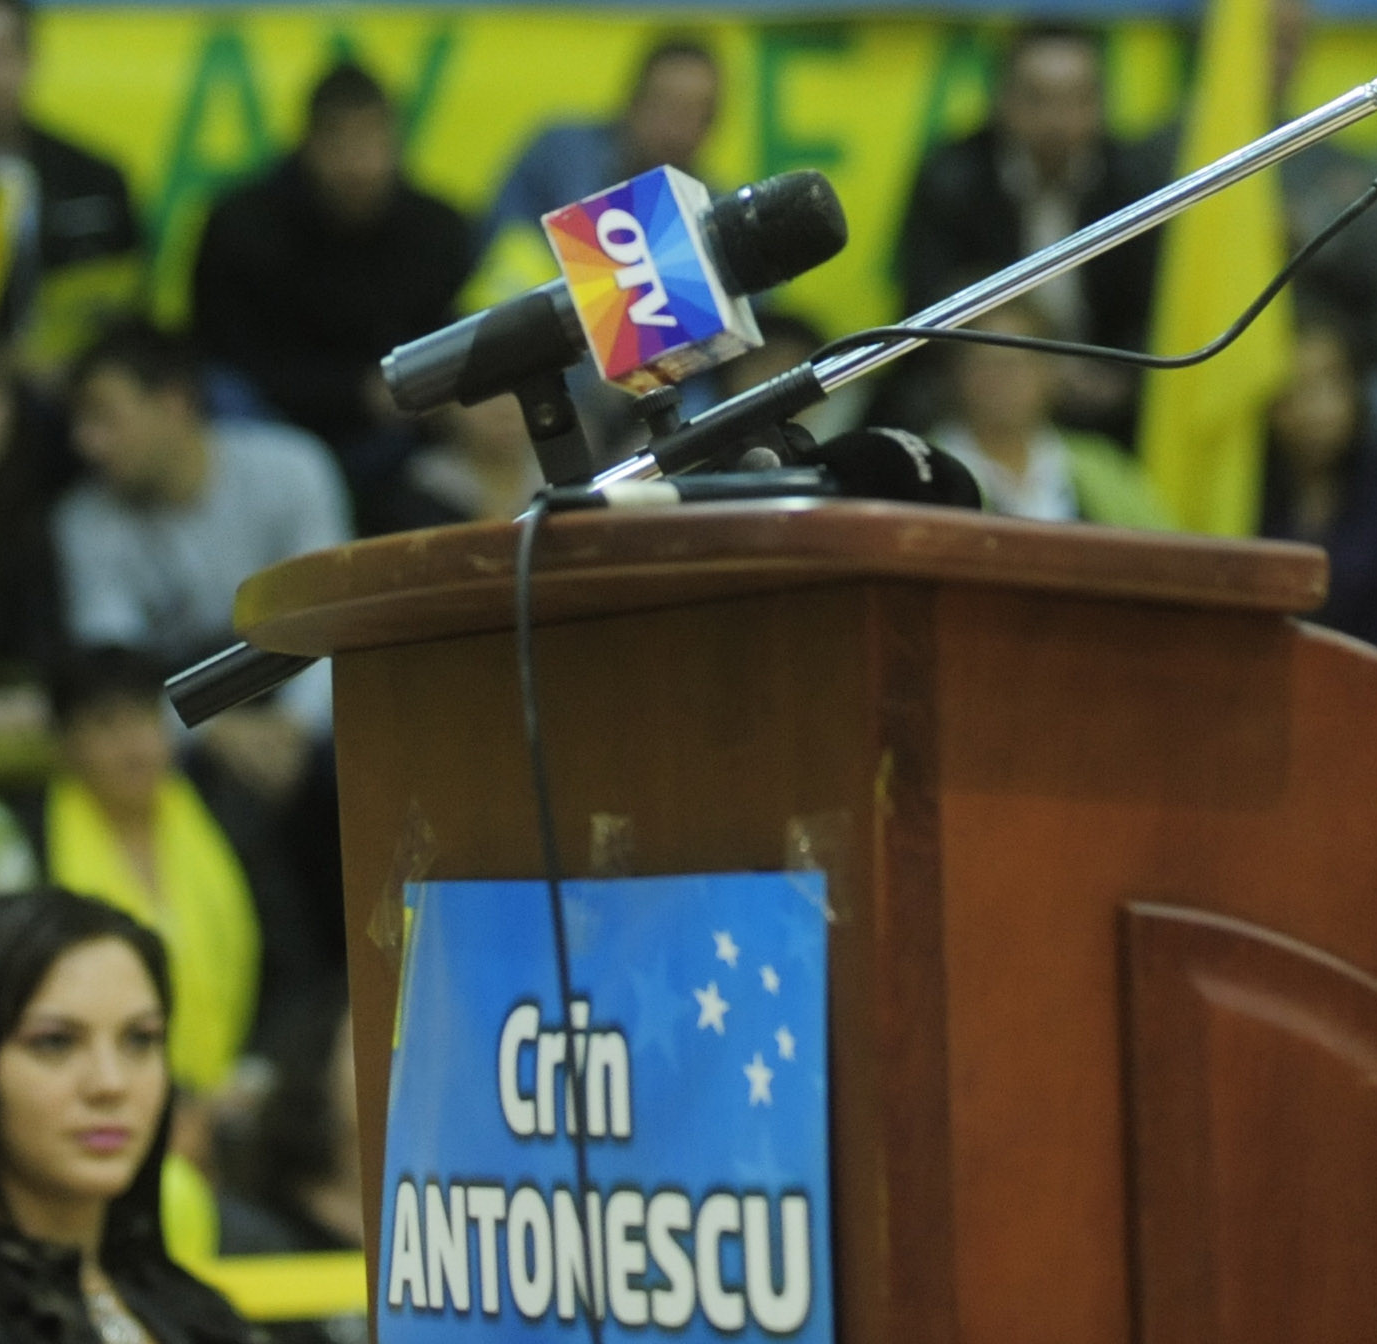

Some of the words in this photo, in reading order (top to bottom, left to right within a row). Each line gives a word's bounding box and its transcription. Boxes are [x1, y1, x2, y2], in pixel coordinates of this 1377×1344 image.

[596, 208, 679, 328] OTV
[497, 999, 633, 1138] Crin
[387, 1180, 811, 1334] ANTONESCU
